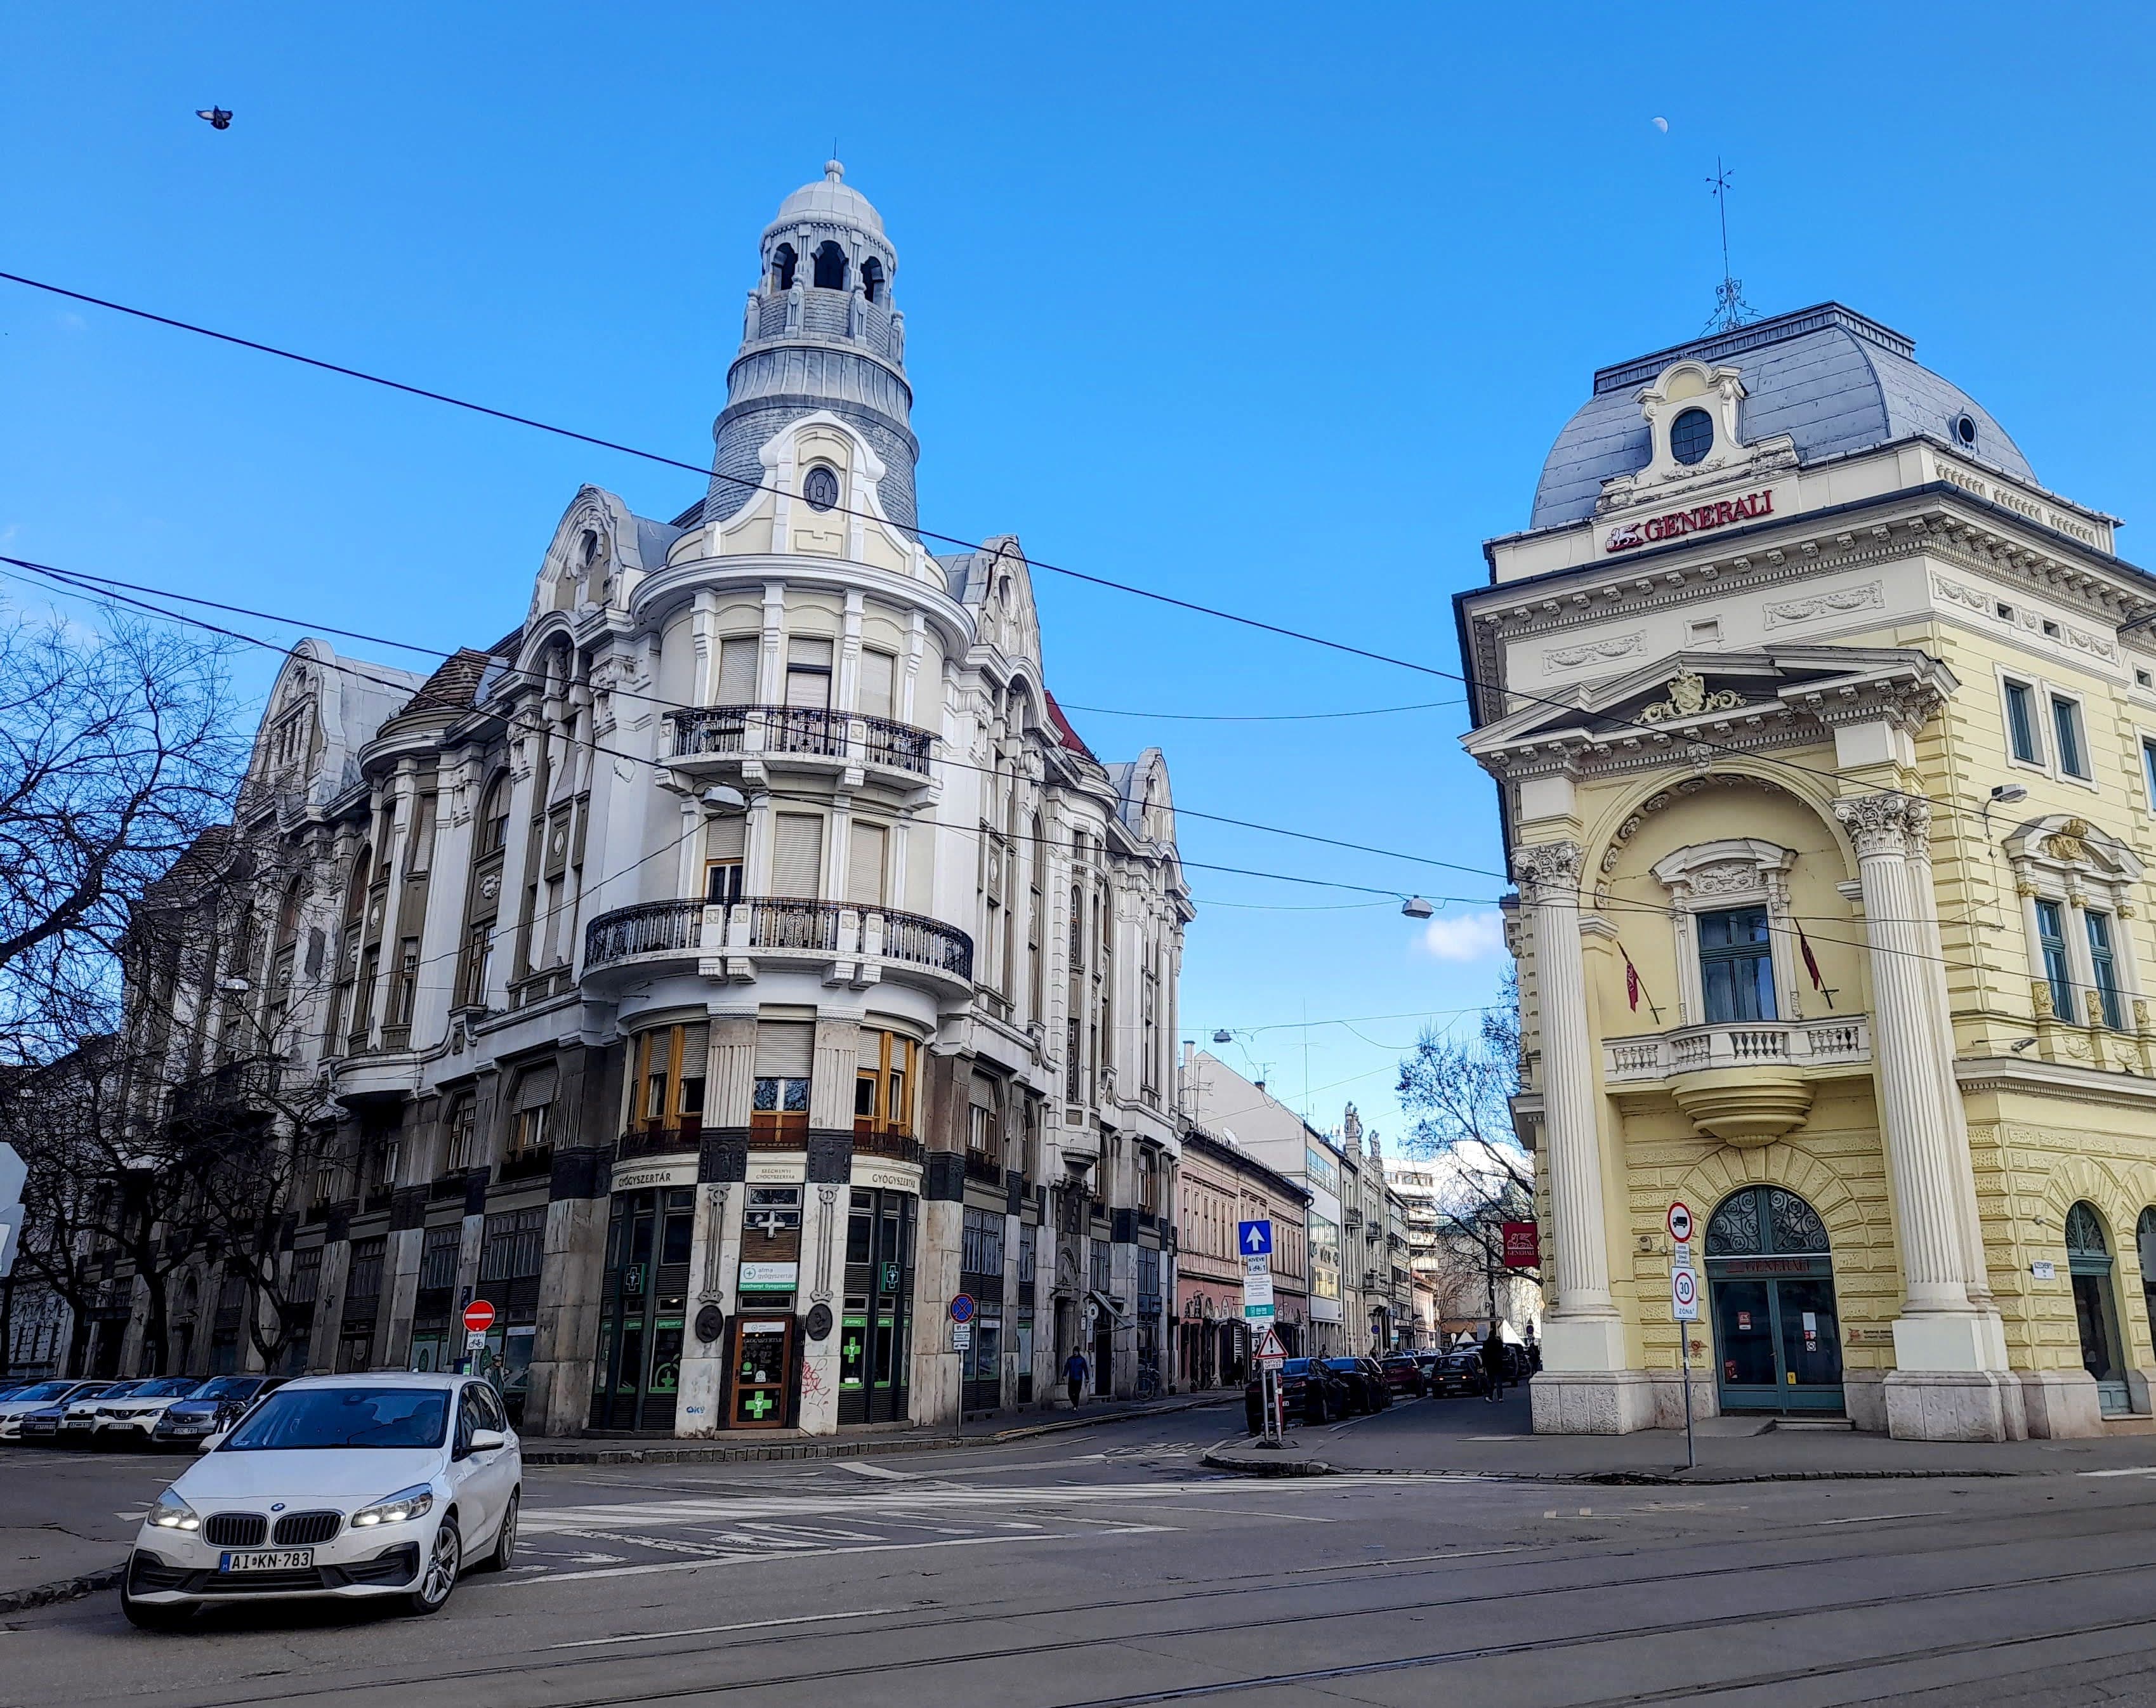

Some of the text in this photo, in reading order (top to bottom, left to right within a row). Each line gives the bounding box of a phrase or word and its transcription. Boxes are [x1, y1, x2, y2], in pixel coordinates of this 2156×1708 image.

[1645, 489, 1775, 541] GENERALI
[618, 1171, 671, 1187] GYÓGYSZERTÁR
[1679, 1282, 1690, 1295] 30
